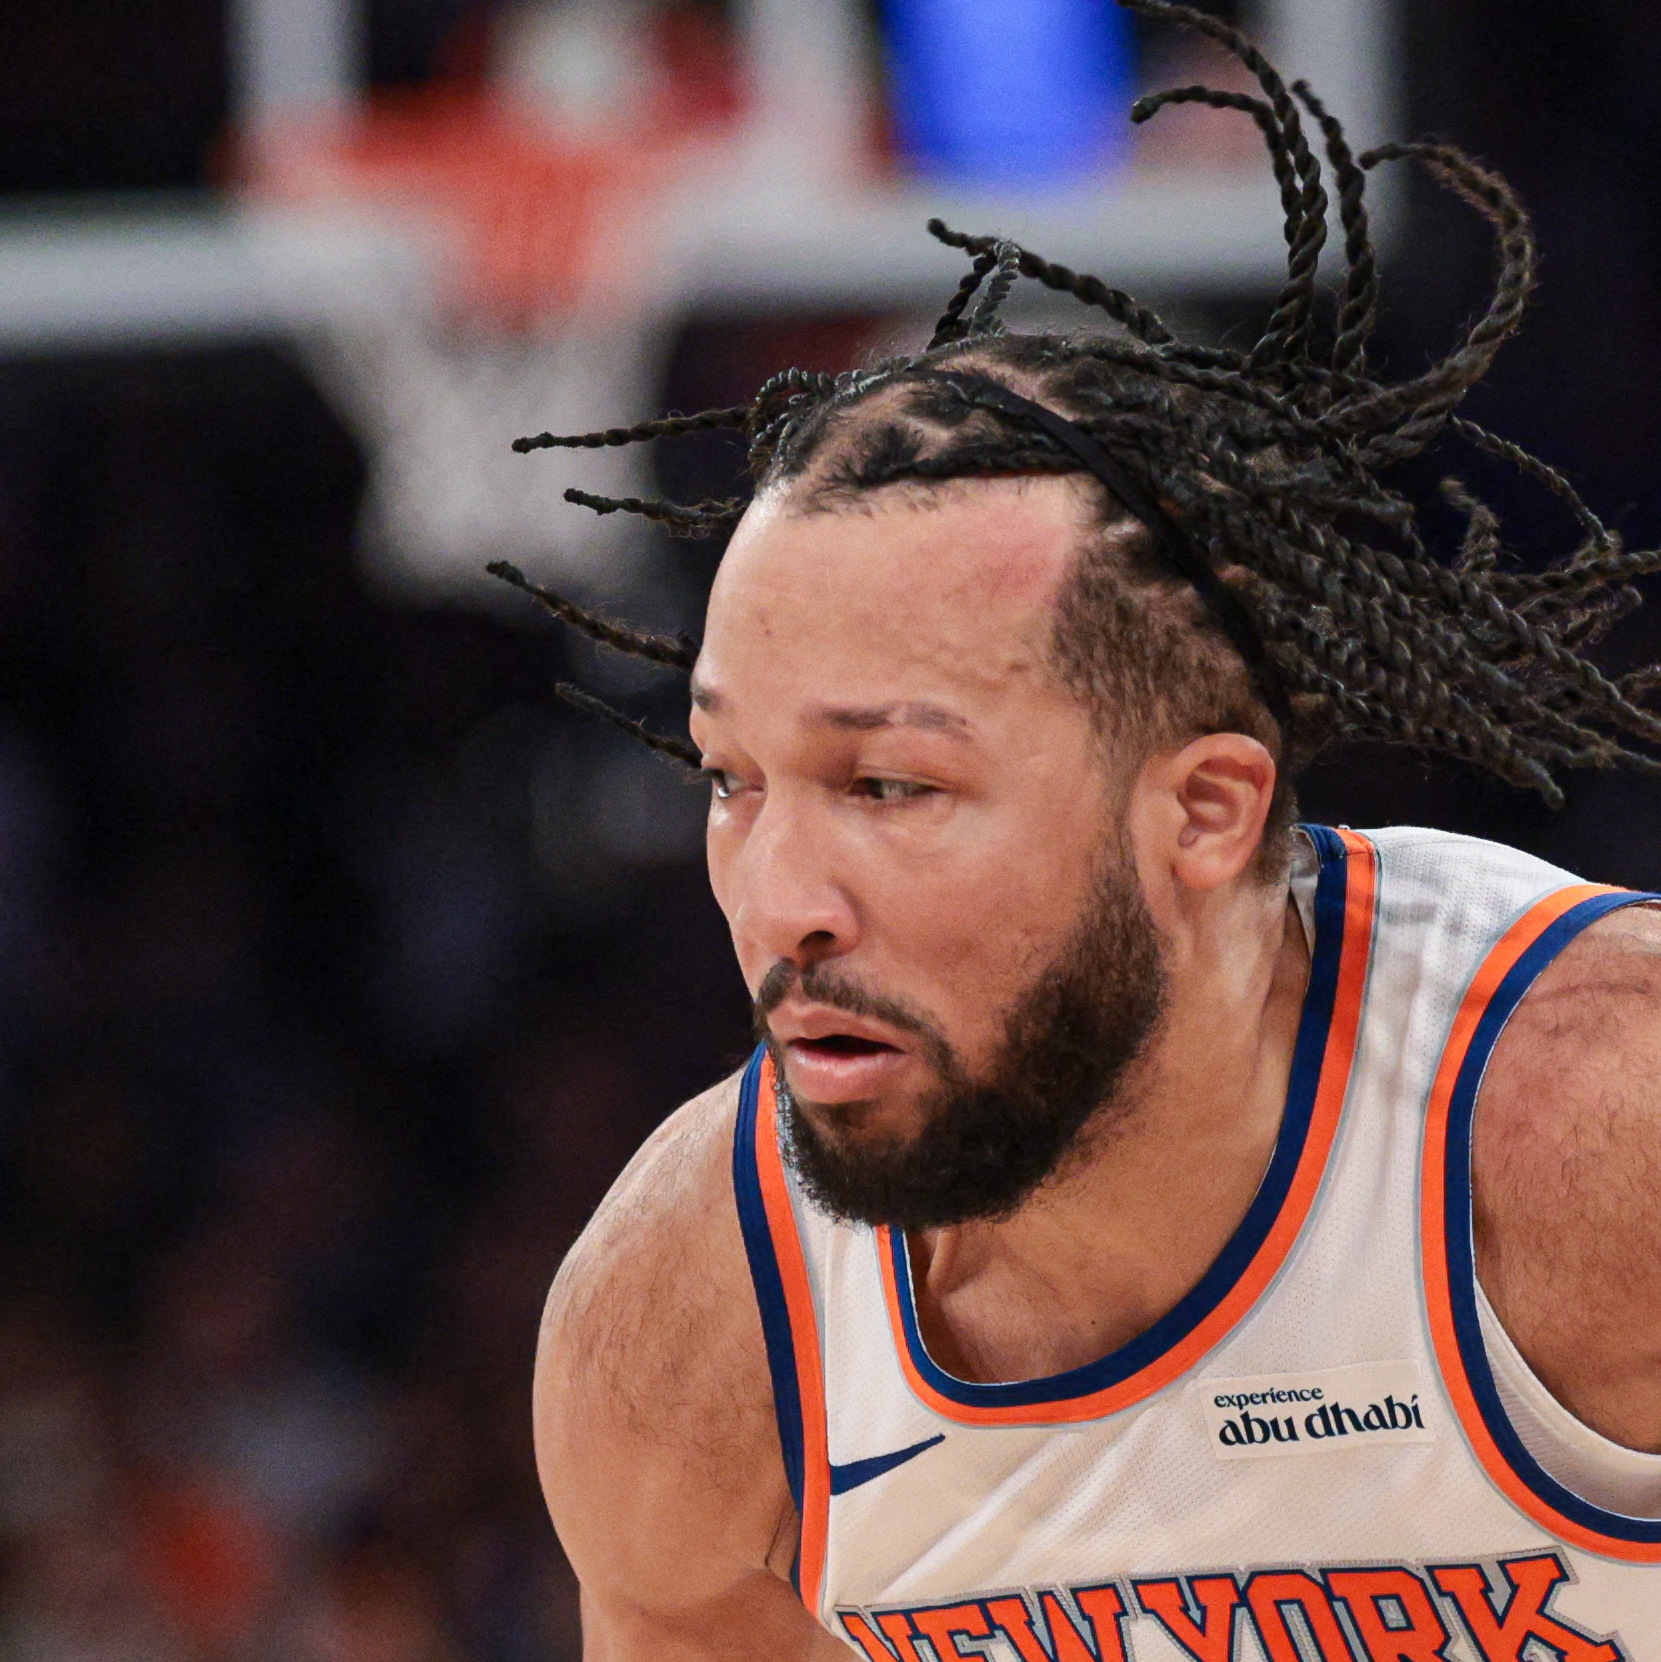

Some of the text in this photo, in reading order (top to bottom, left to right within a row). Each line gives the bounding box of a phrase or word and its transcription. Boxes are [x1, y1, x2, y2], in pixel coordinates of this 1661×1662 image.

[1213, 1387, 1324, 1410] experience
[1218, 1394, 1425, 1446] abu dhabi
